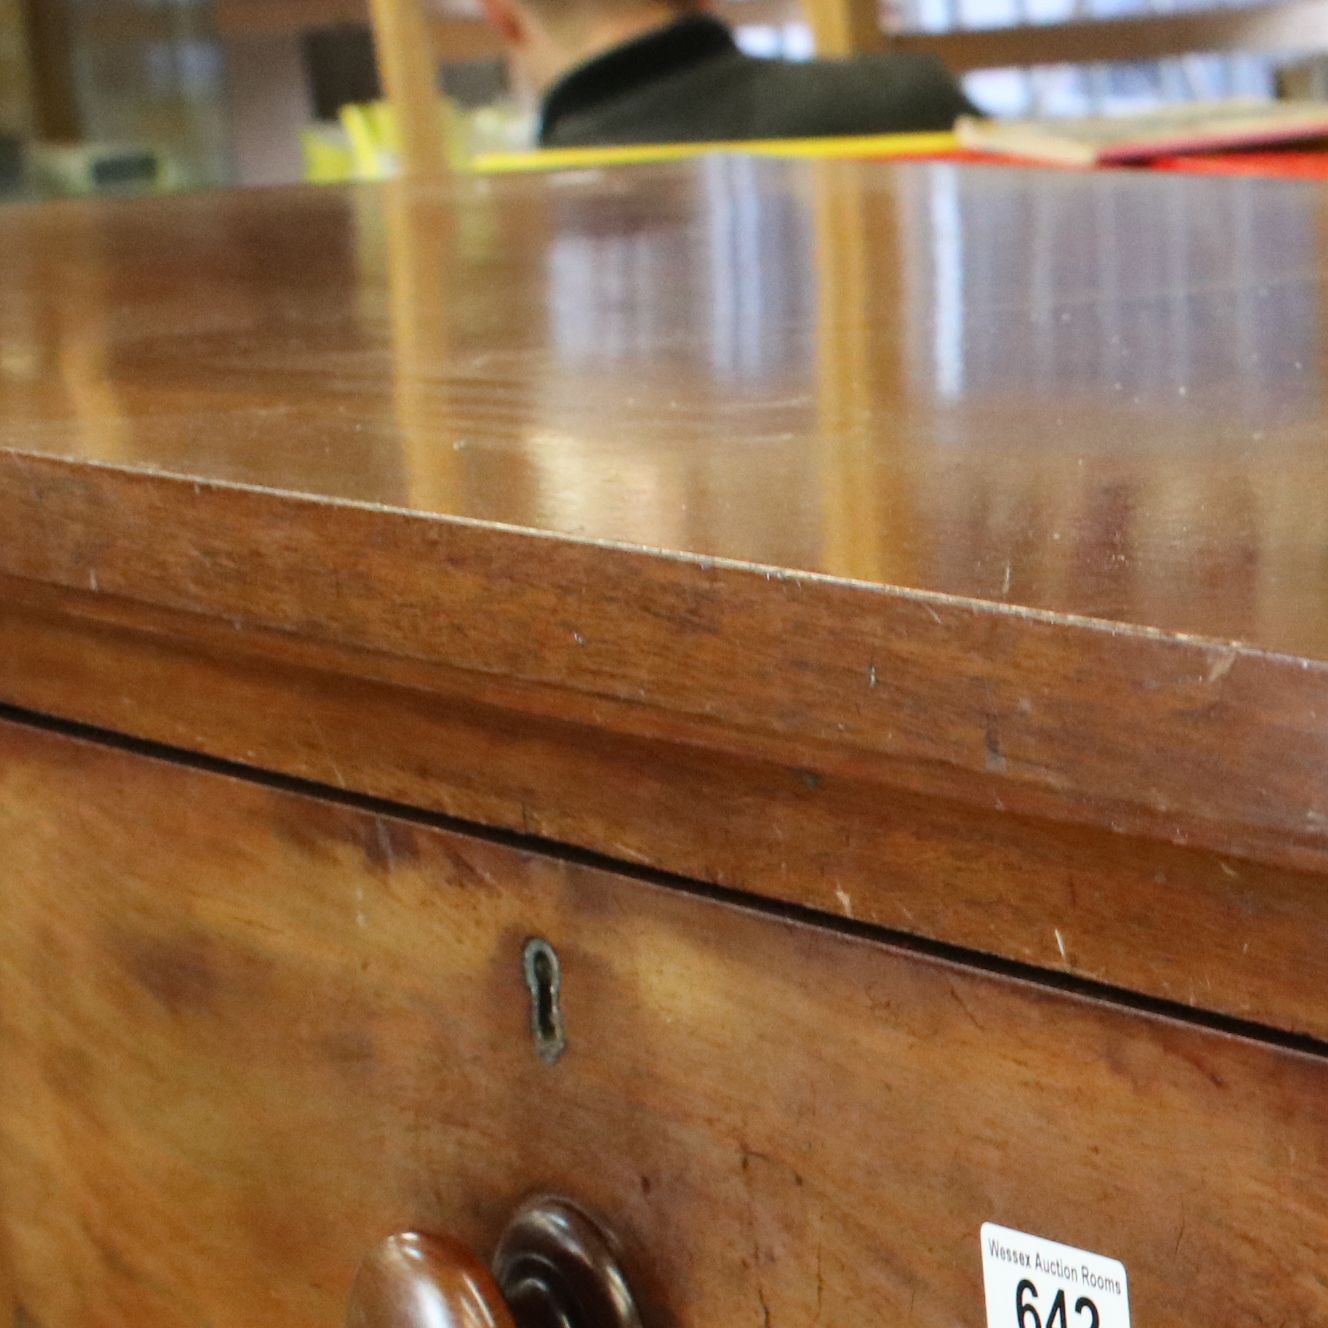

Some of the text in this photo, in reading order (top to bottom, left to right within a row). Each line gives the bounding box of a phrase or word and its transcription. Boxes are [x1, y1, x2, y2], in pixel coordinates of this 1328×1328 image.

[988, 1238, 1121, 1295] Wessex Auction Rooms
